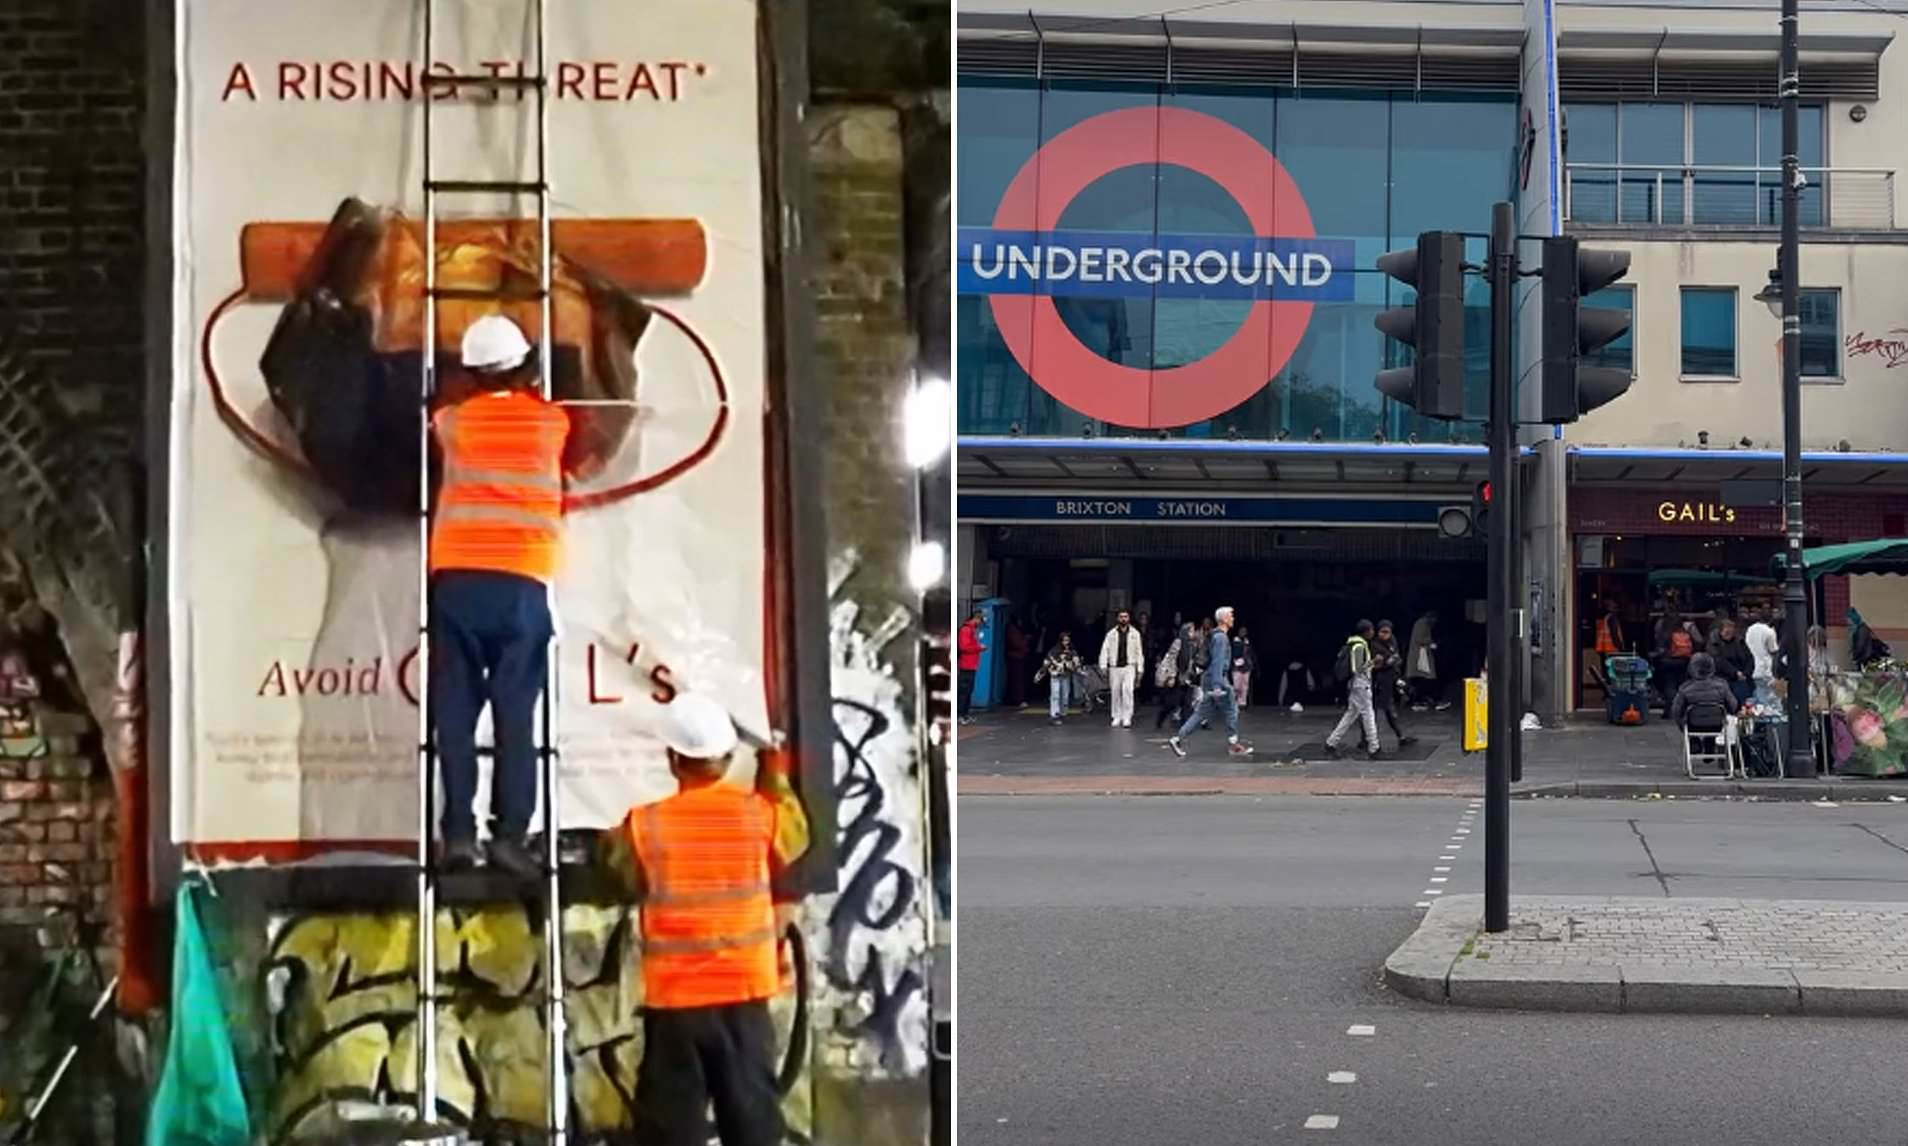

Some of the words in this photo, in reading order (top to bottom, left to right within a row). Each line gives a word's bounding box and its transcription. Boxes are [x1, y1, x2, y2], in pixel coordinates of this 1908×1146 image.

[222, 62, 256, 101] A
[278, 61, 459, 101] RISING
[972, 243, 1333, 287] UNDERGROUND
[1056, 501, 1131, 515] BRIXTON
[1157, 502, 1226, 516] STATION
[257, 657, 382, 696] Avoid
